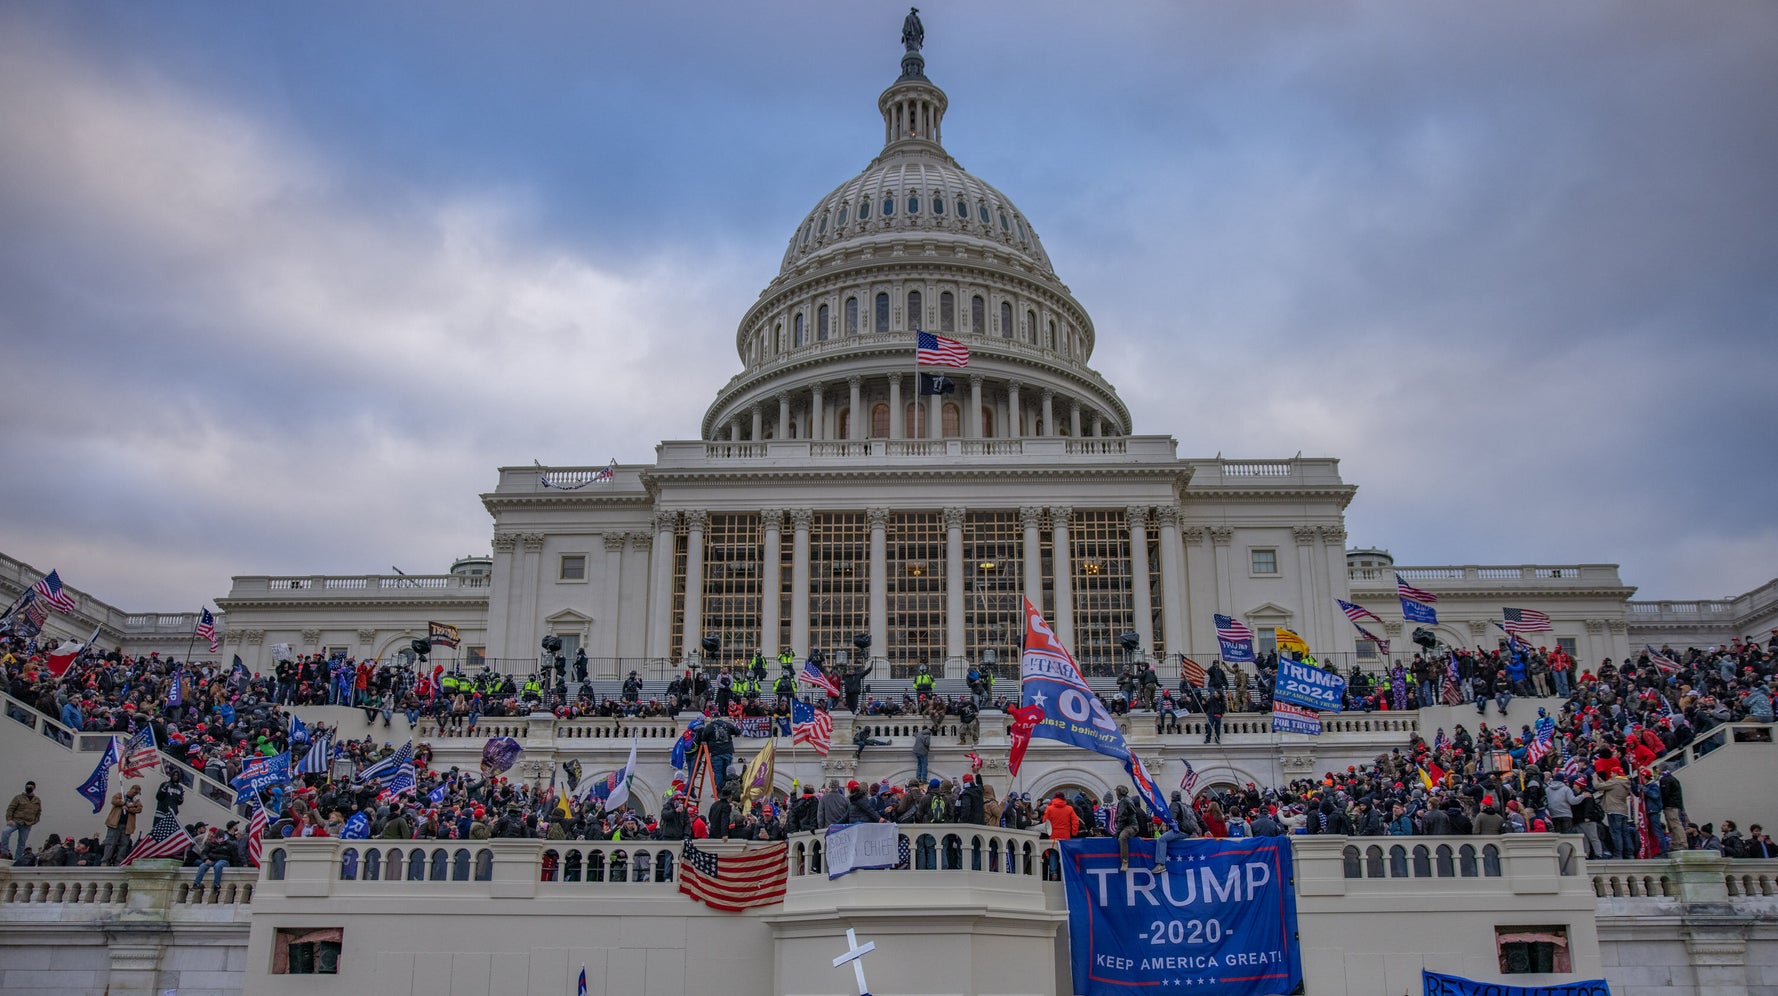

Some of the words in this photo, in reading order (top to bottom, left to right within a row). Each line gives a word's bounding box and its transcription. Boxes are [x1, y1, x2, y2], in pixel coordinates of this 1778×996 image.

[1280, 659, 1344, 688] TRUMP
[1286, 680, 1335, 701] 2024
[1292, 691, 1319, 704] AMERICA
[742, 729, 769, 737] AND
[1274, 717, 1290, 728] FOR
[1291, 720, 1321, 731] TRUMP
[864, 838, 894, 857] CHIEF
[1086, 861, 1271, 907] TRUMP
[1096, 953, 1134, 971] KEEP
[1140, 956, 1219, 971] AMERICA
[1225, 950, 1283, 967] GREAT!
